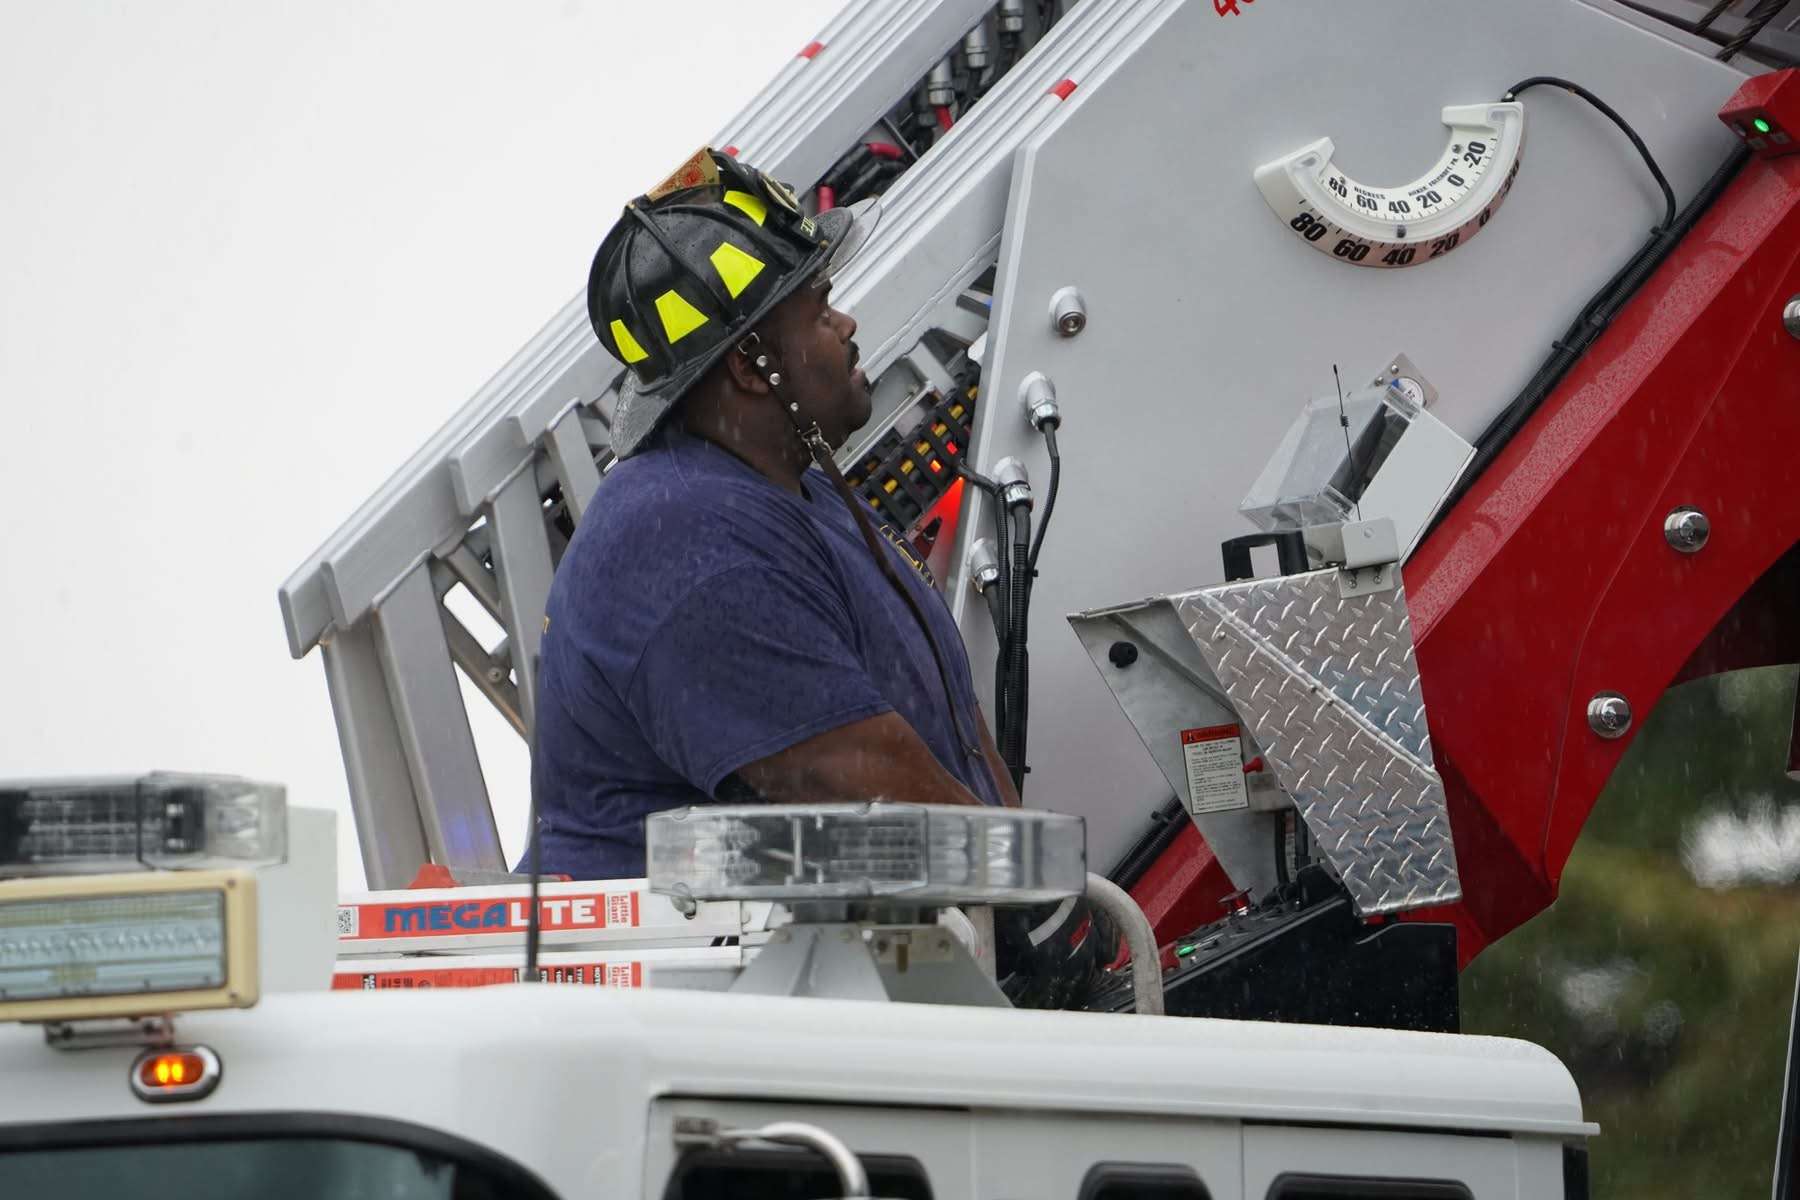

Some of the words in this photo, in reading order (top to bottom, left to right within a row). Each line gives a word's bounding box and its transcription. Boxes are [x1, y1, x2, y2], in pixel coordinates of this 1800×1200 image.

[1329, 177, 1347, 198] 80
[1356, 194, 1378, 211] 60
[1388, 200, 1411, 213] 40
[1416, 190, 1443, 209] 20
[1447, 174, 1465, 187] 0
[1463, 141, 1486, 169] -20
[1290, 212, 1327, 242] 80
[1333, 238, 1371, 262] 60
[1381, 247, 1416, 265] 40
[1429, 232, 1460, 257] 20
[384, 899, 596, 932] MEGALTE
[611, 895, 620, 923] Giant
[620, 895, 629, 923] Little
